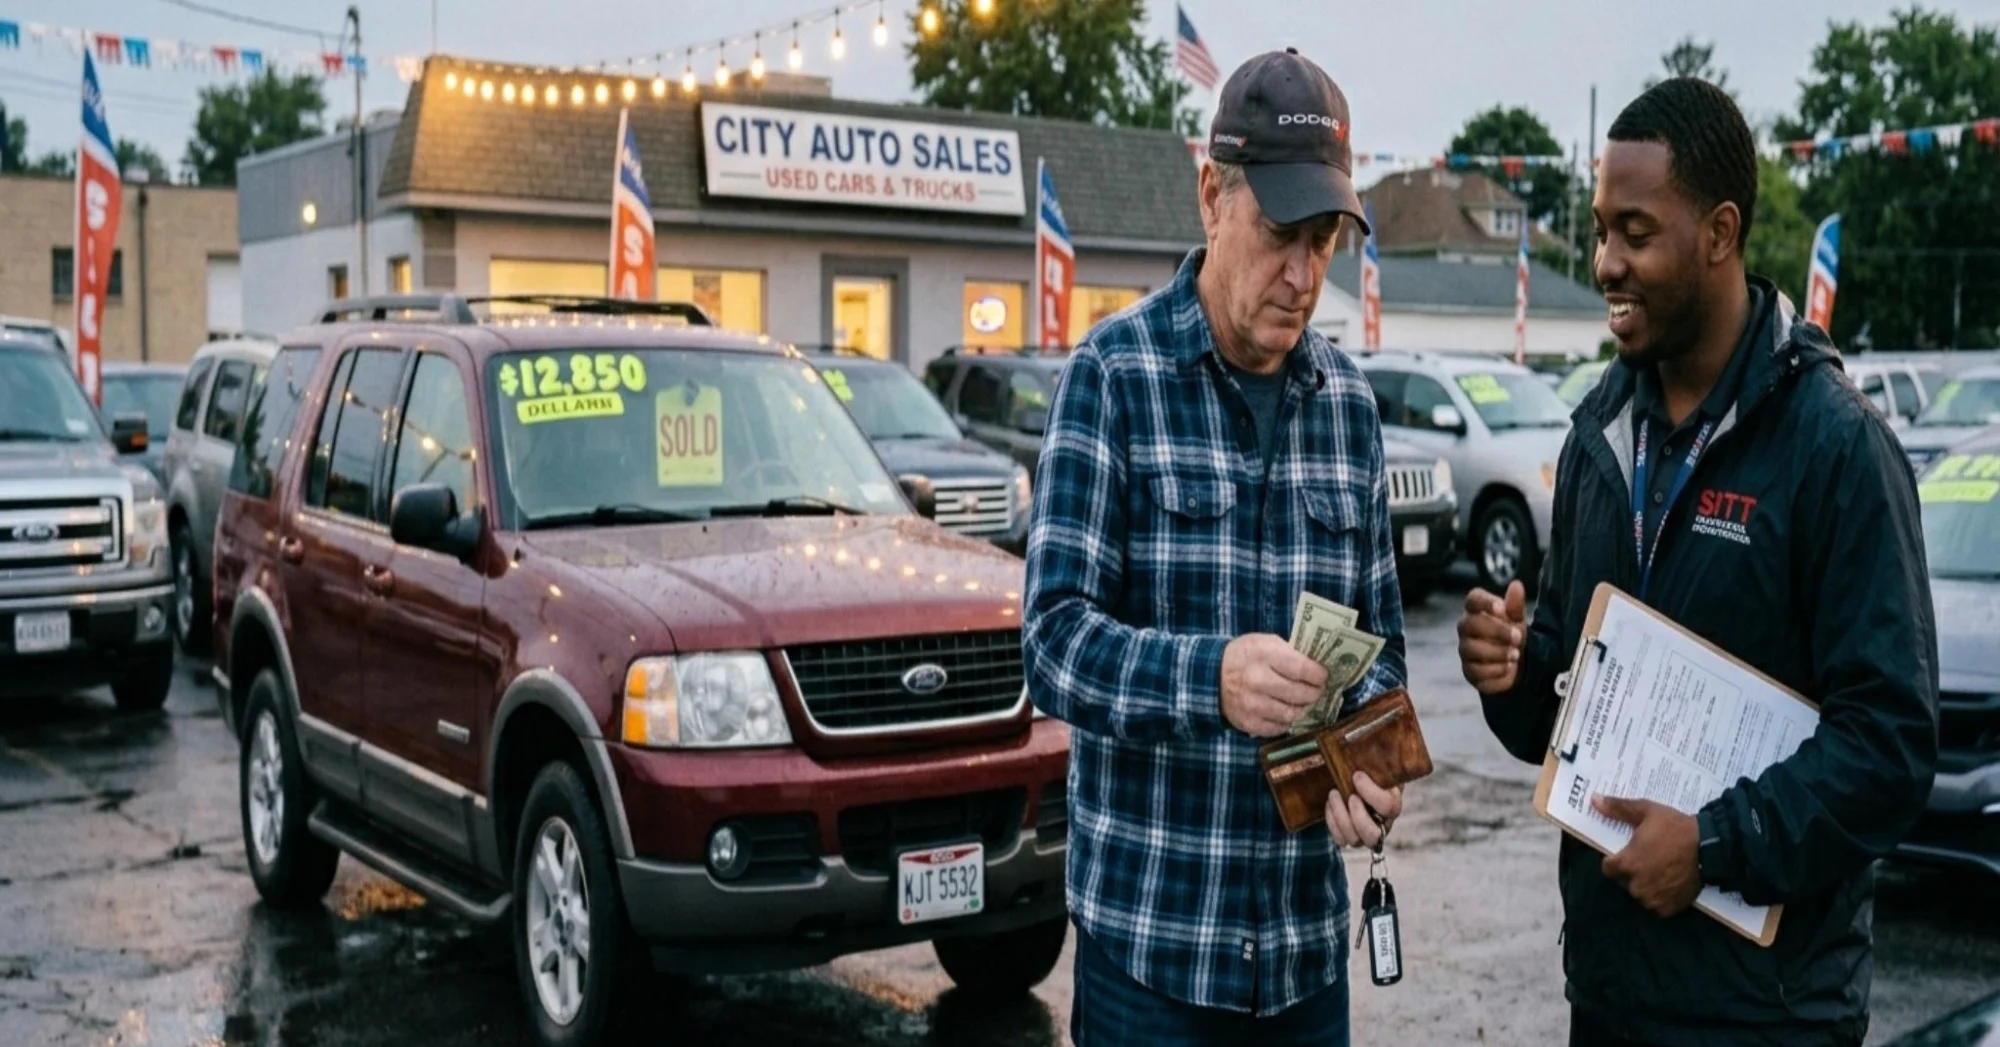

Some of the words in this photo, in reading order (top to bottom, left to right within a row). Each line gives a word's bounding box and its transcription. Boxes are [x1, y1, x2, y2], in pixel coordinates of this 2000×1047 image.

[716, 116, 795, 157] CITY
[810, 124, 902, 166] AUTO
[913, 133, 1012, 175] SALES
[766, 168, 819, 191] USED
[825, 173, 876, 195] CARS
[883, 178, 895, 196] &
[903, 179, 977, 202] TRUCKS
[500, 354, 647, 397] $12,850
[660, 414, 718, 458] SOLD
[1698, 489, 1757, 524] SITT
[905, 870, 933, 905] KJT
[939, 864, 977, 900] 5532
